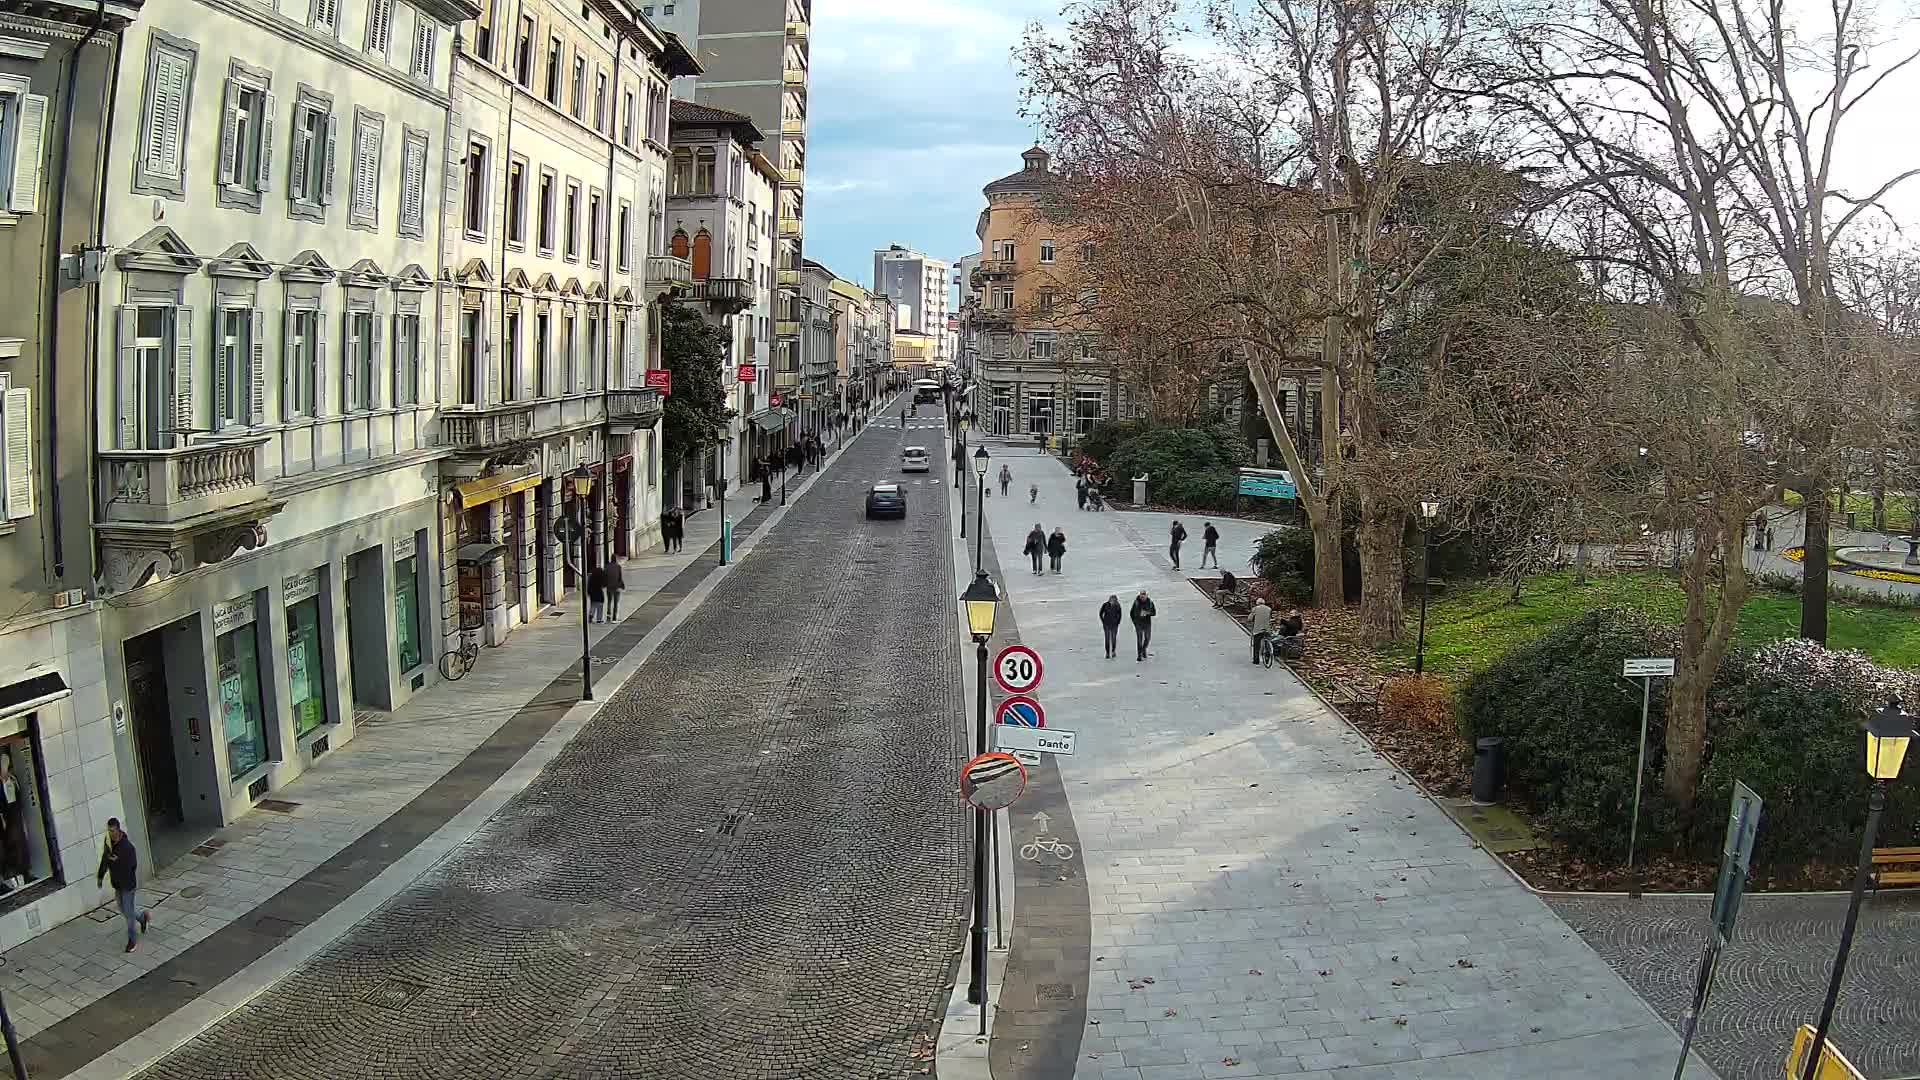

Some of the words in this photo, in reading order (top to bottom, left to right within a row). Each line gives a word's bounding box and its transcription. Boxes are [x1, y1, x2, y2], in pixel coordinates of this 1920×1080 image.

[1005, 658, 1033, 681] 30
[222, 678, 241, 701] 130
[1038, 738, 1070, 750] Dante
